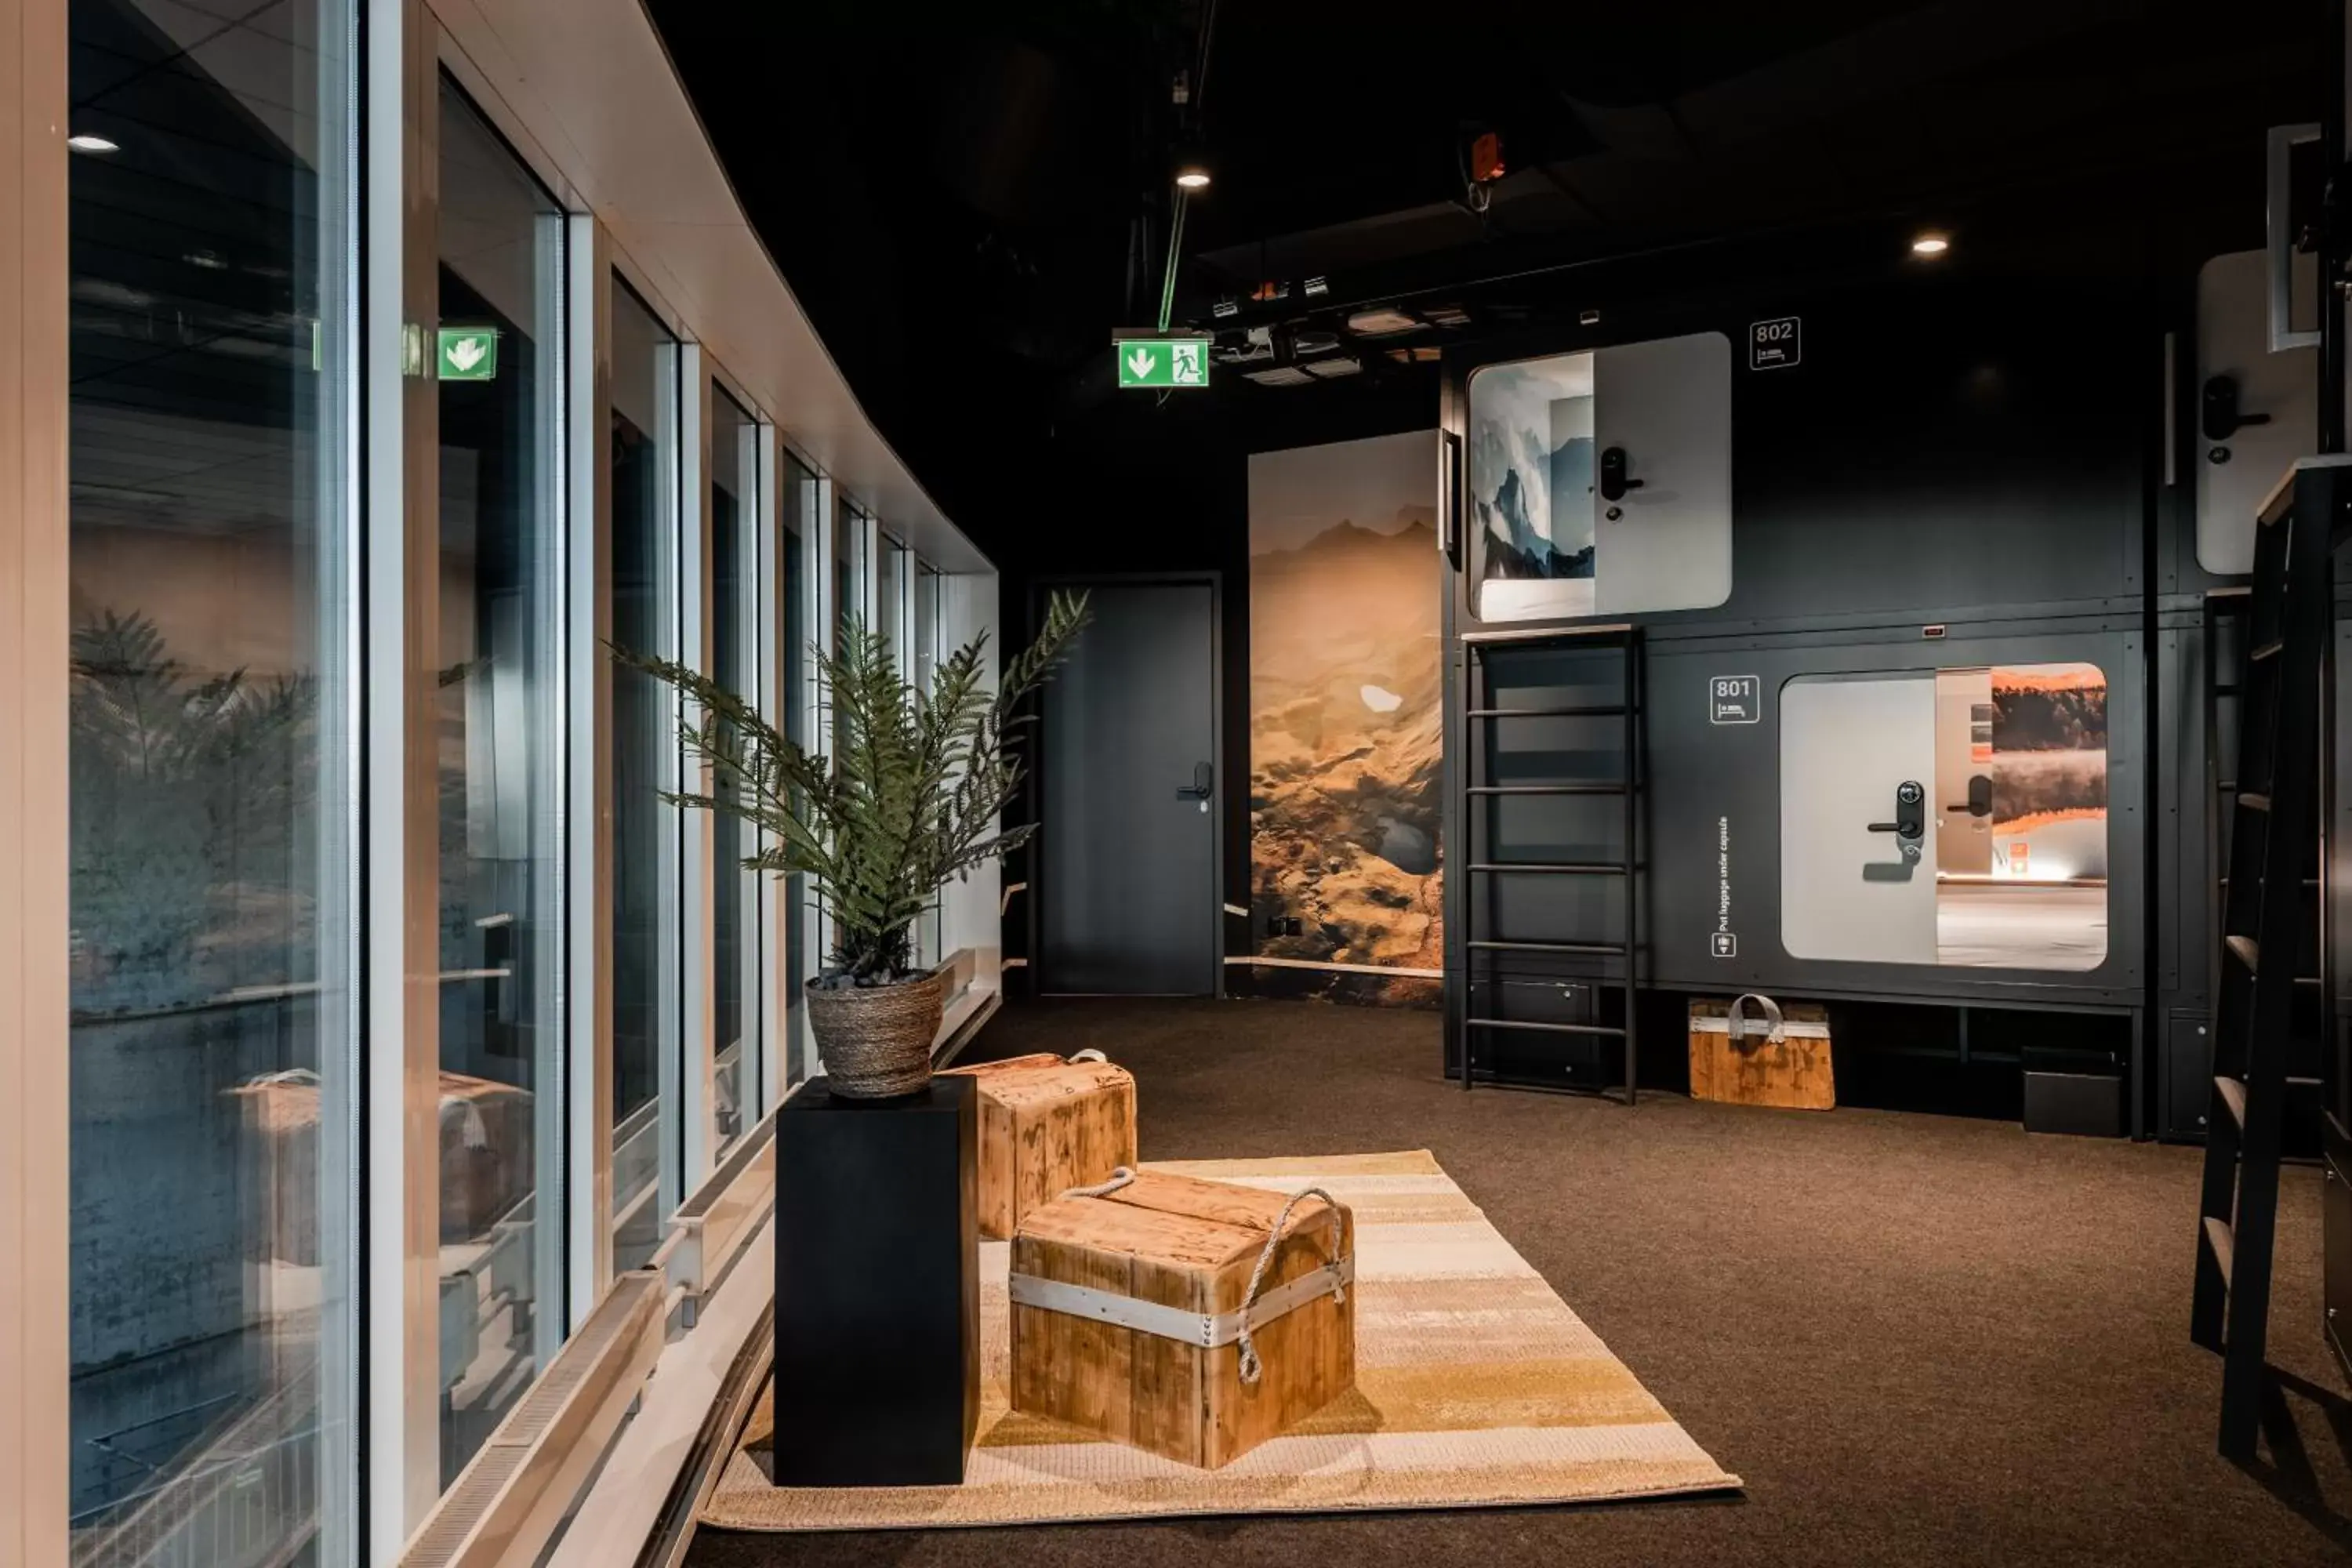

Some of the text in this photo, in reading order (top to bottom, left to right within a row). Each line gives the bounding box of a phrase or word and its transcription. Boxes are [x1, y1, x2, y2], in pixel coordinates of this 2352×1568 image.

[1756, 322, 1793, 342] 802
[1718, 681, 1749, 697] 801
[1719, 816, 1730, 932] Put luggage under capsule
